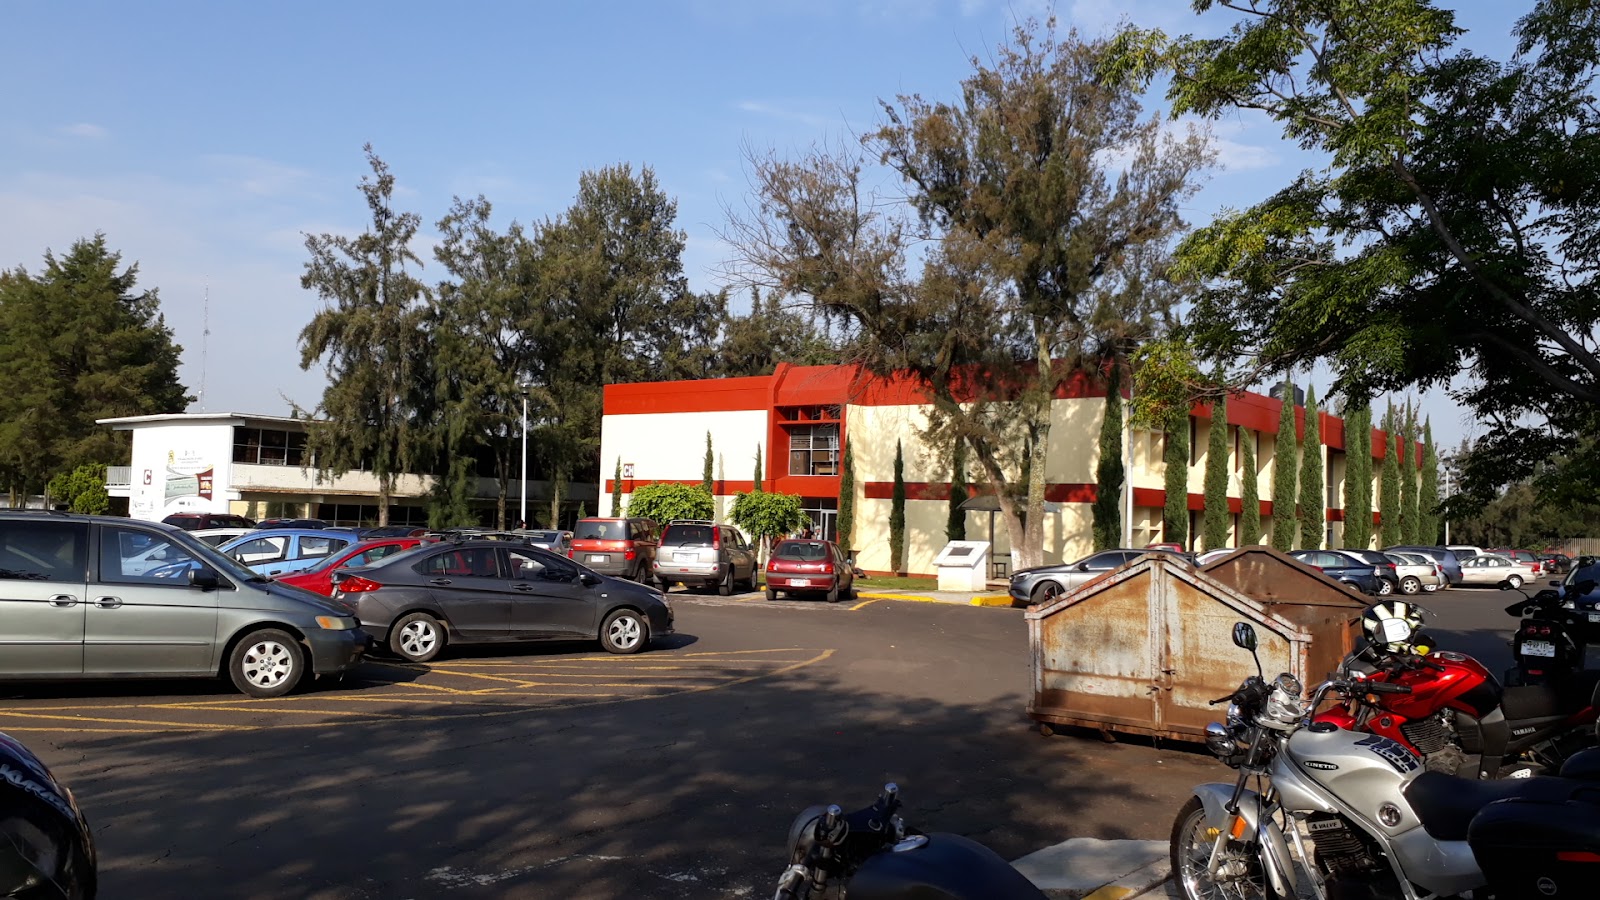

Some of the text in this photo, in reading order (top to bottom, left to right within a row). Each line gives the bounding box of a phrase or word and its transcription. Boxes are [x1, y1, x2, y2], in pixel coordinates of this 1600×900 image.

[624, 465, 634, 477] CH
[1513, 727, 1536, 736] YAMAHA
[1305, 762, 1336, 770] KINETIC
